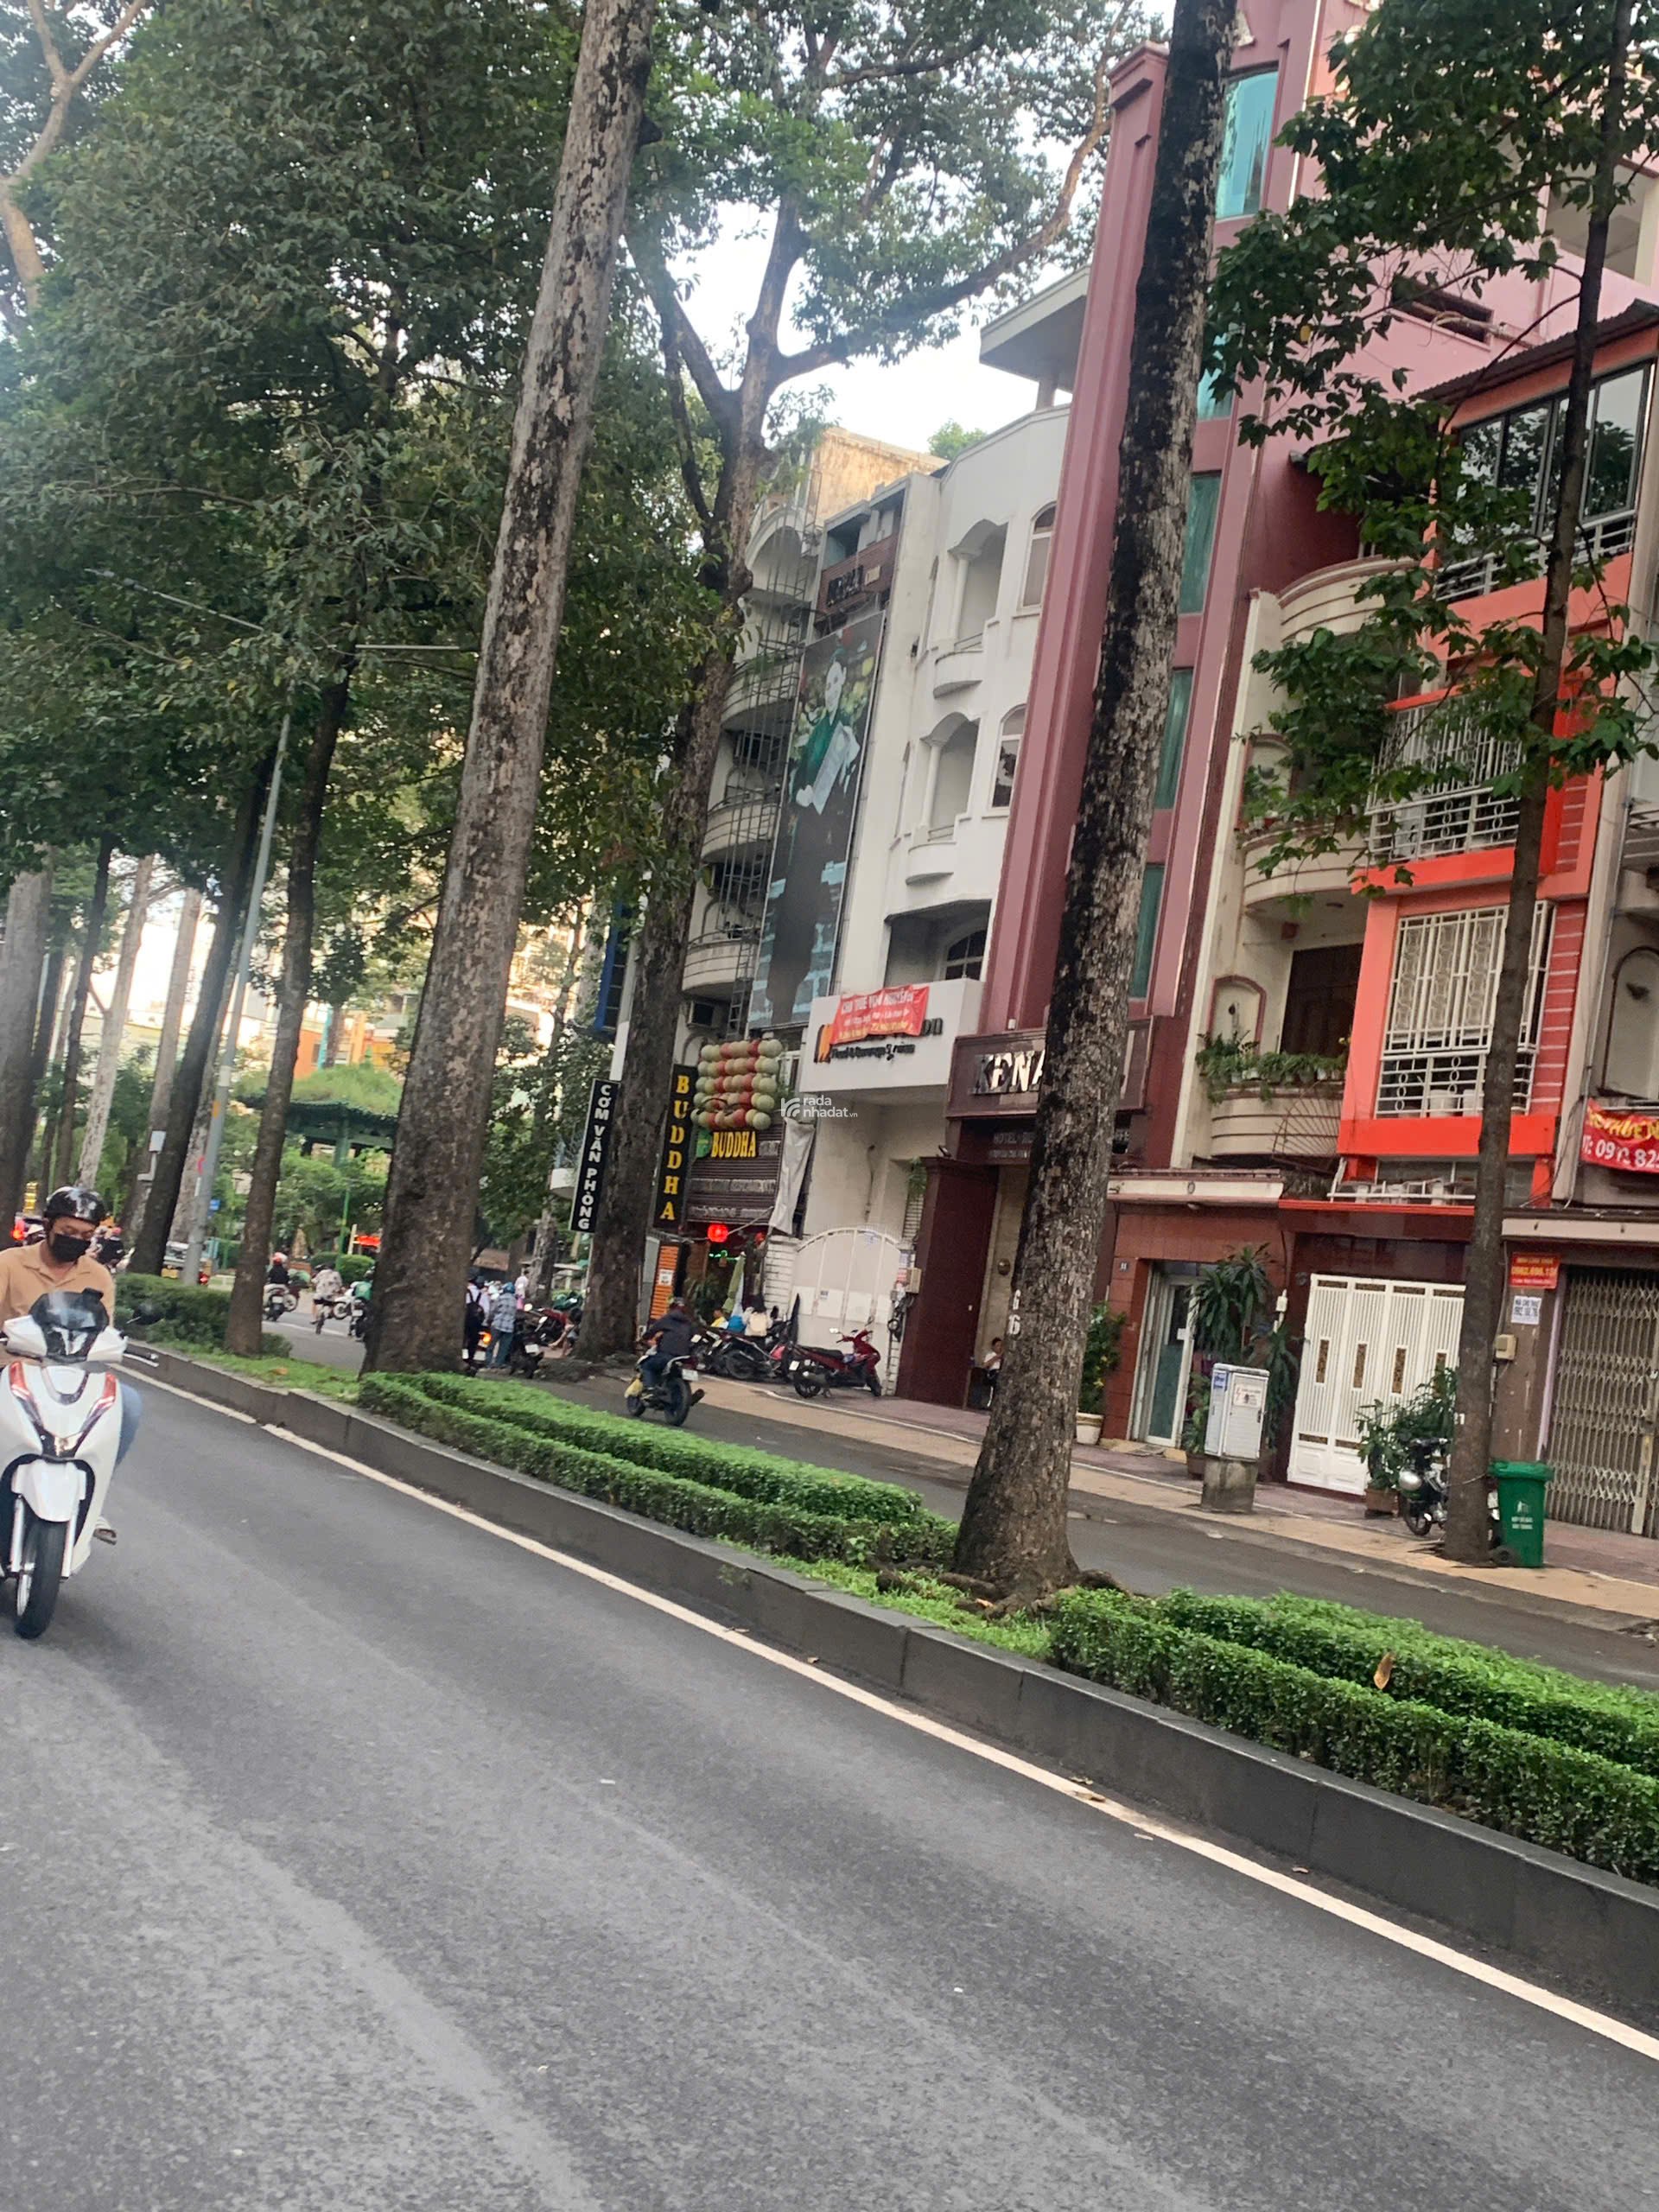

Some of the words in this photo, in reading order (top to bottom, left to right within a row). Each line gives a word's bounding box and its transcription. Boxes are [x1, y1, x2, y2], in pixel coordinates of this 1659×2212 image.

[594, 1084, 612, 1121] CƠM
[588, 1124, 606, 1163] VĂN
[659, 1074, 690, 1220] BUDDHA
[710, 1131, 757, 1159] BUDDHA
[577, 1167, 598, 1230] PHÒNG
